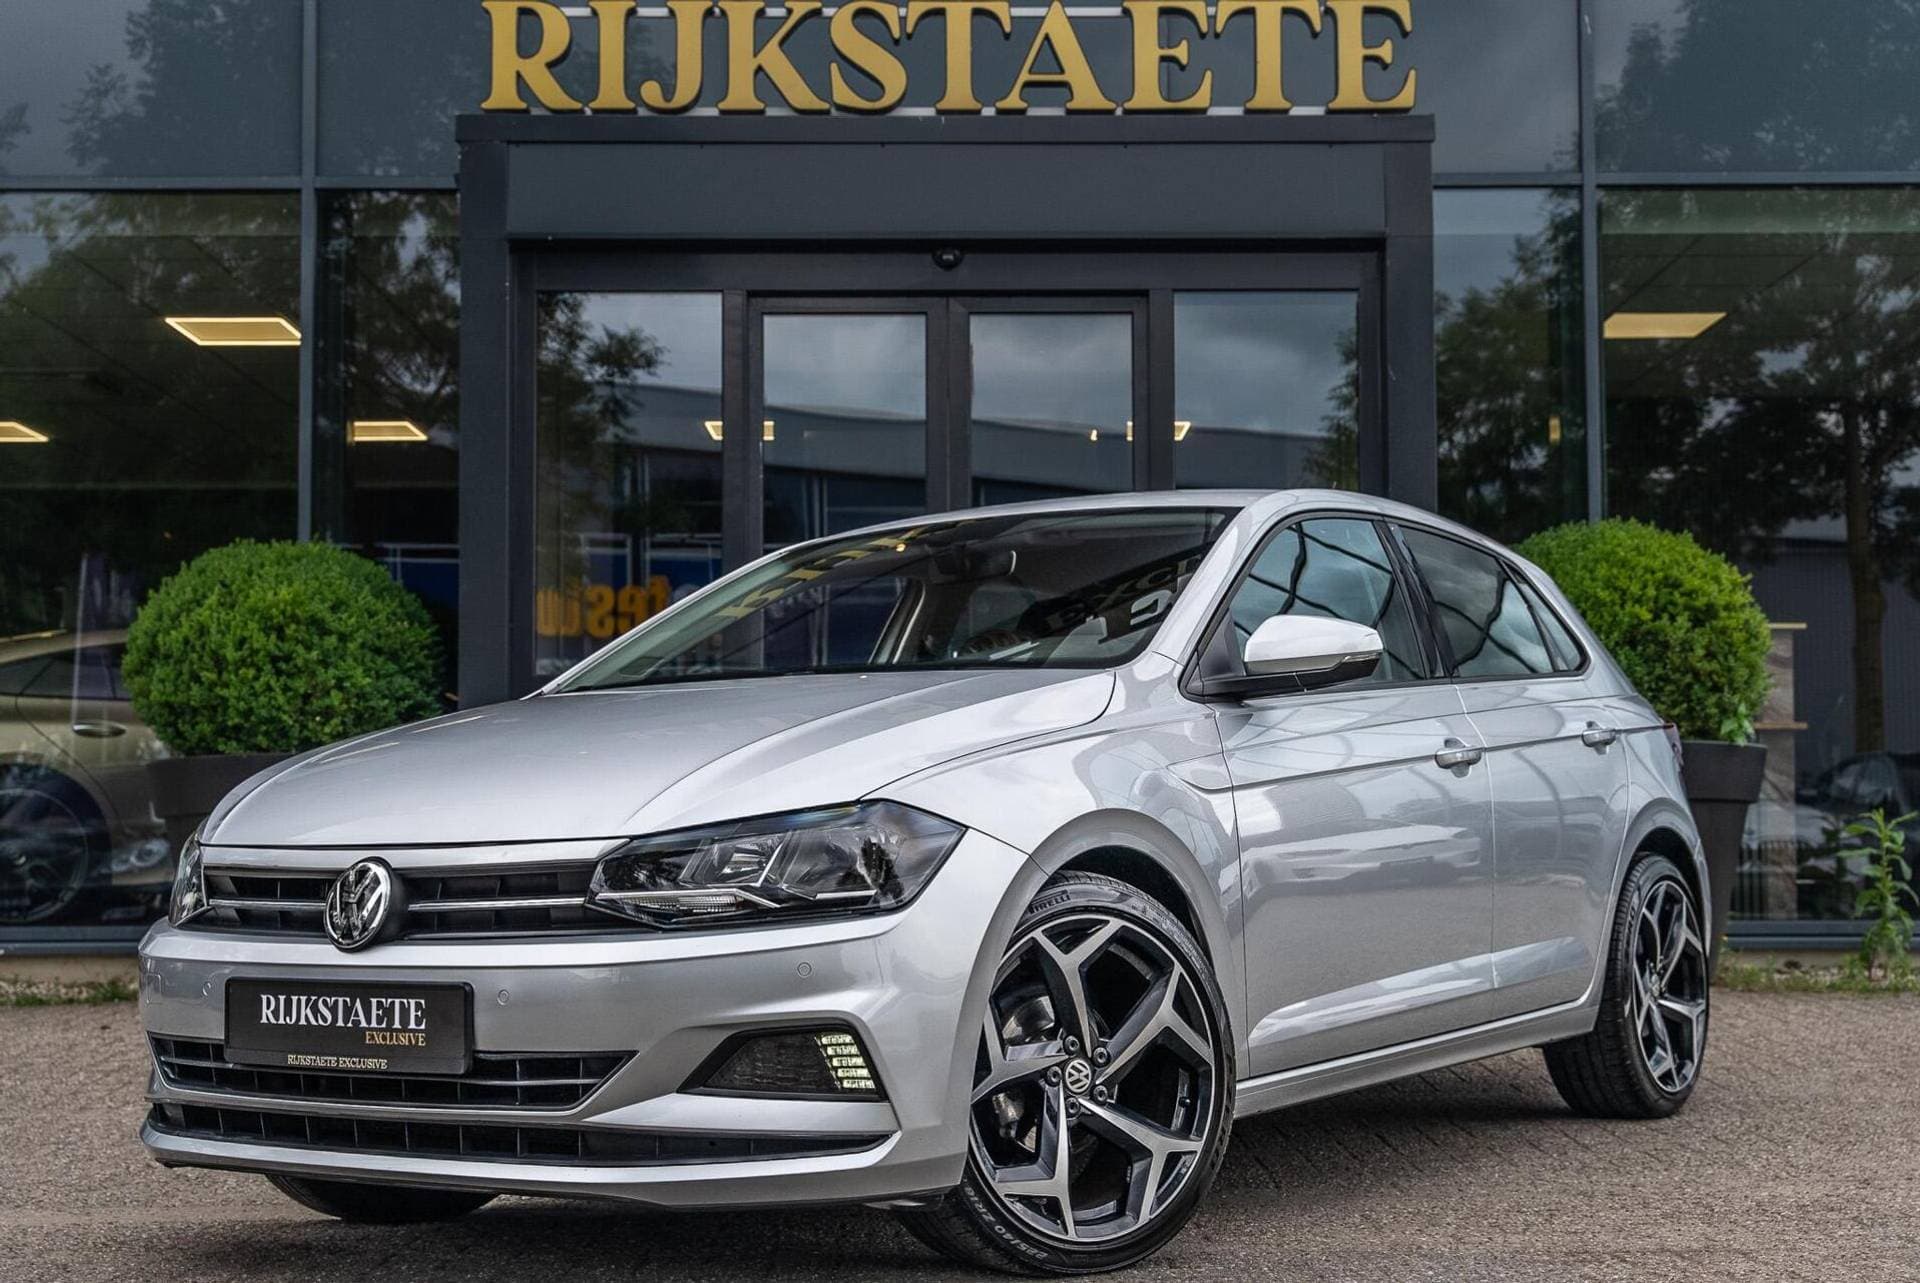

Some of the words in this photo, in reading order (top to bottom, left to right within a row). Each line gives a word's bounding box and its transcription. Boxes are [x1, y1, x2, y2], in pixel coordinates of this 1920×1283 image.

[480, 0, 1417, 112] RIJKSTAETE
[260, 994, 426, 1030] RIJKSTAETE
[365, 1031, 426, 1047] EXCLUSIVE
[287, 1054, 338, 1067] RIJKSTAETE
[338, 1057, 388, 1070] EXCLUSIVE
